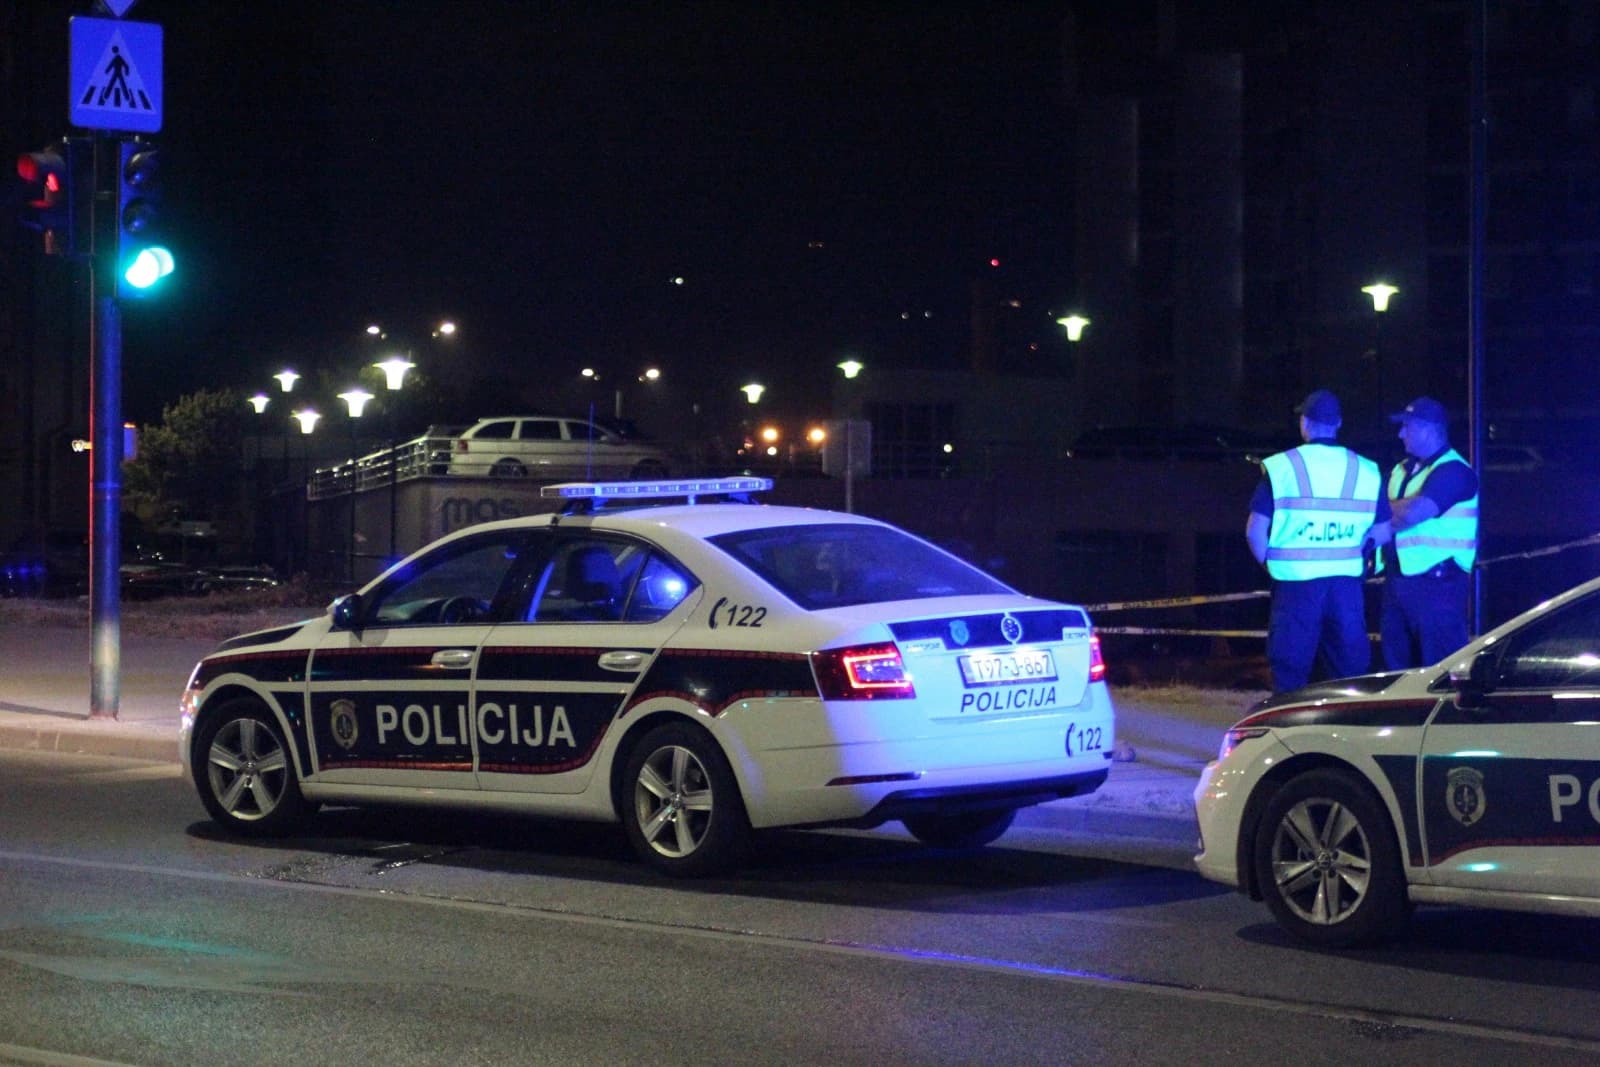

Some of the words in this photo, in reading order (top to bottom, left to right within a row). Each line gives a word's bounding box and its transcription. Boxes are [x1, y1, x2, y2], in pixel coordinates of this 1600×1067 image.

[727, 604, 767, 627] 122
[960, 686, 1057, 713] POLICIJA
[375, 702, 577, 747] POLICIJA
[1076, 727, 1102, 752] 122
